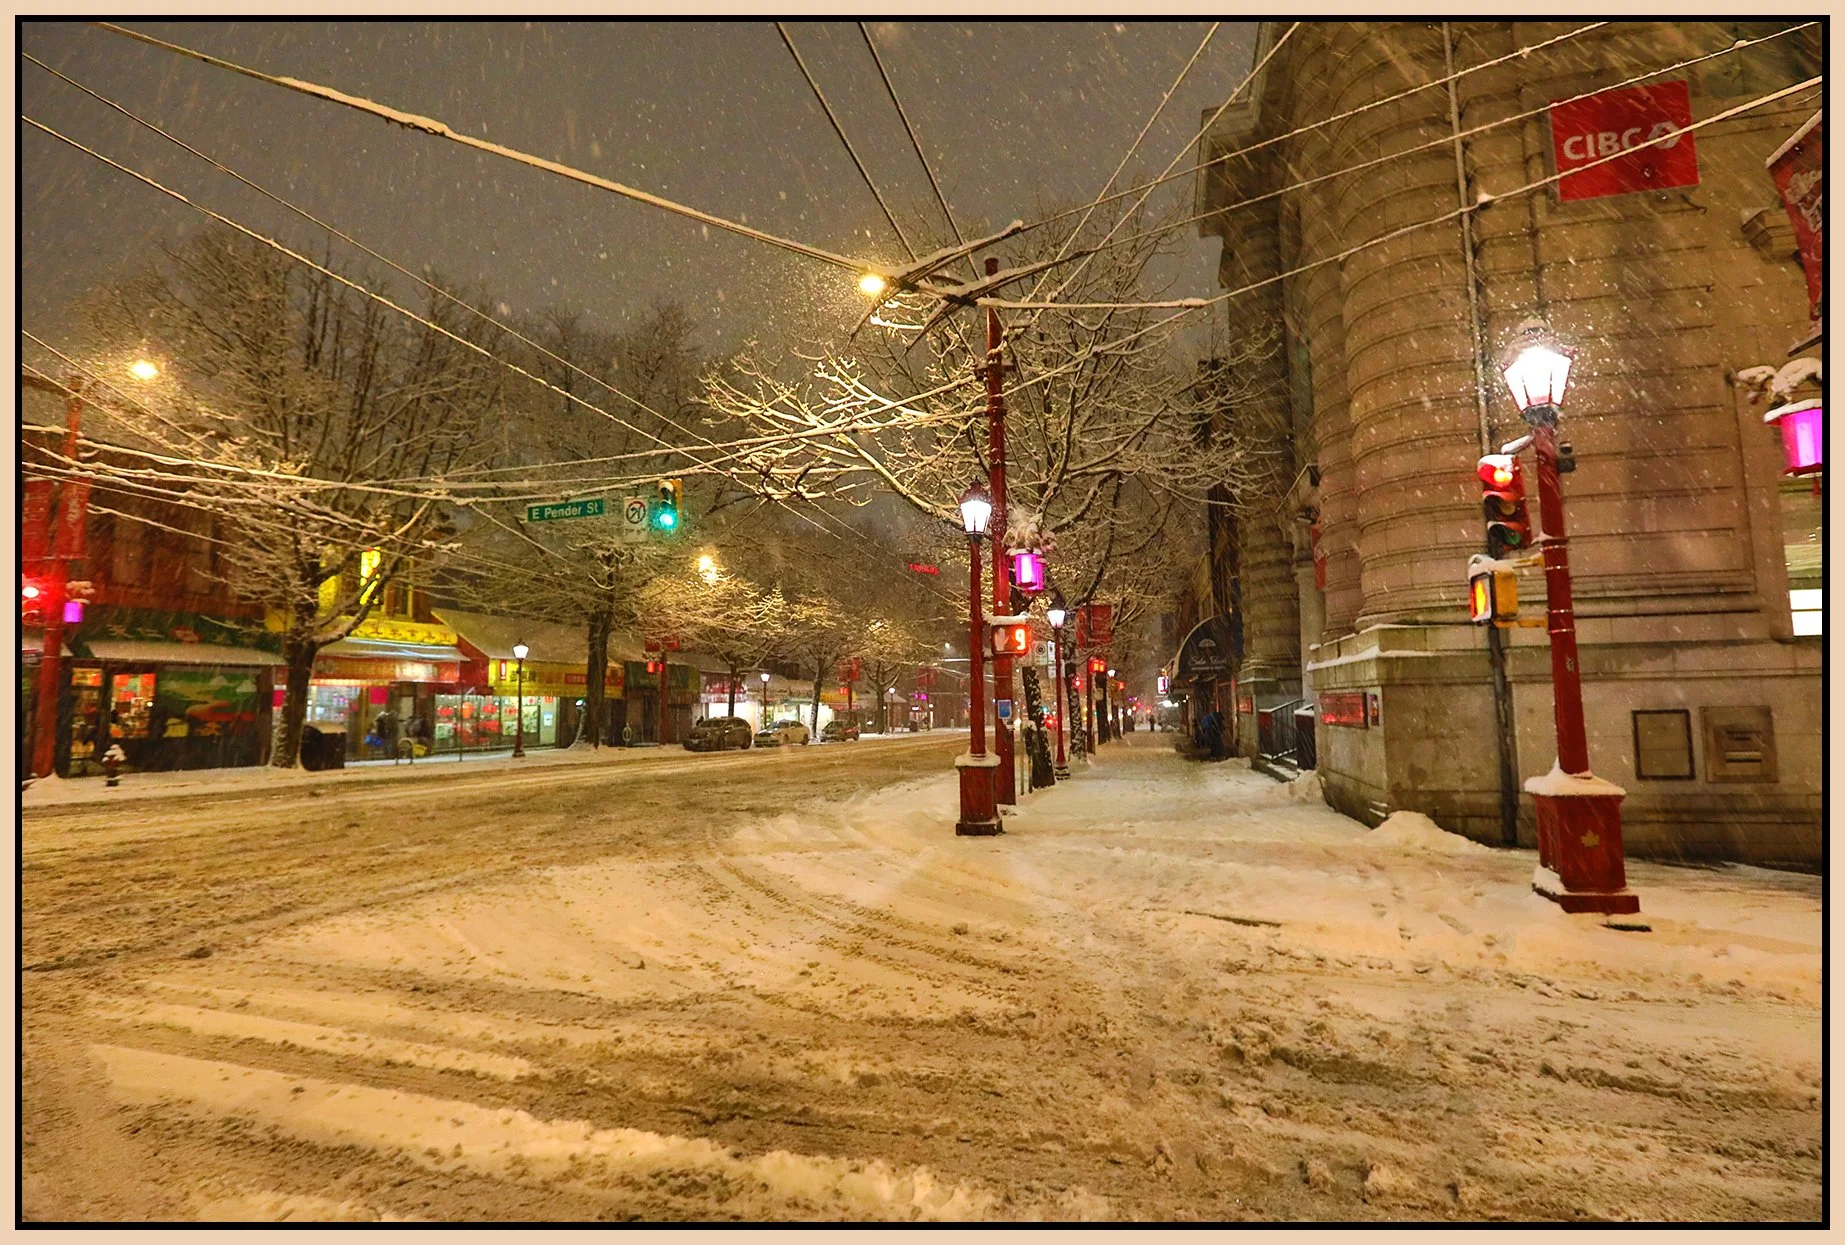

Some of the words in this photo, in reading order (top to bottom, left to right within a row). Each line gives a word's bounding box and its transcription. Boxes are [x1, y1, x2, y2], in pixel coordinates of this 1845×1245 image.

[1563, 127, 1642, 160] CIBC
[532, 508, 540, 519] E
[544, 505, 582, 518] Pender
[586, 502, 599, 514] St
[1015, 628, 1026, 650] 9
